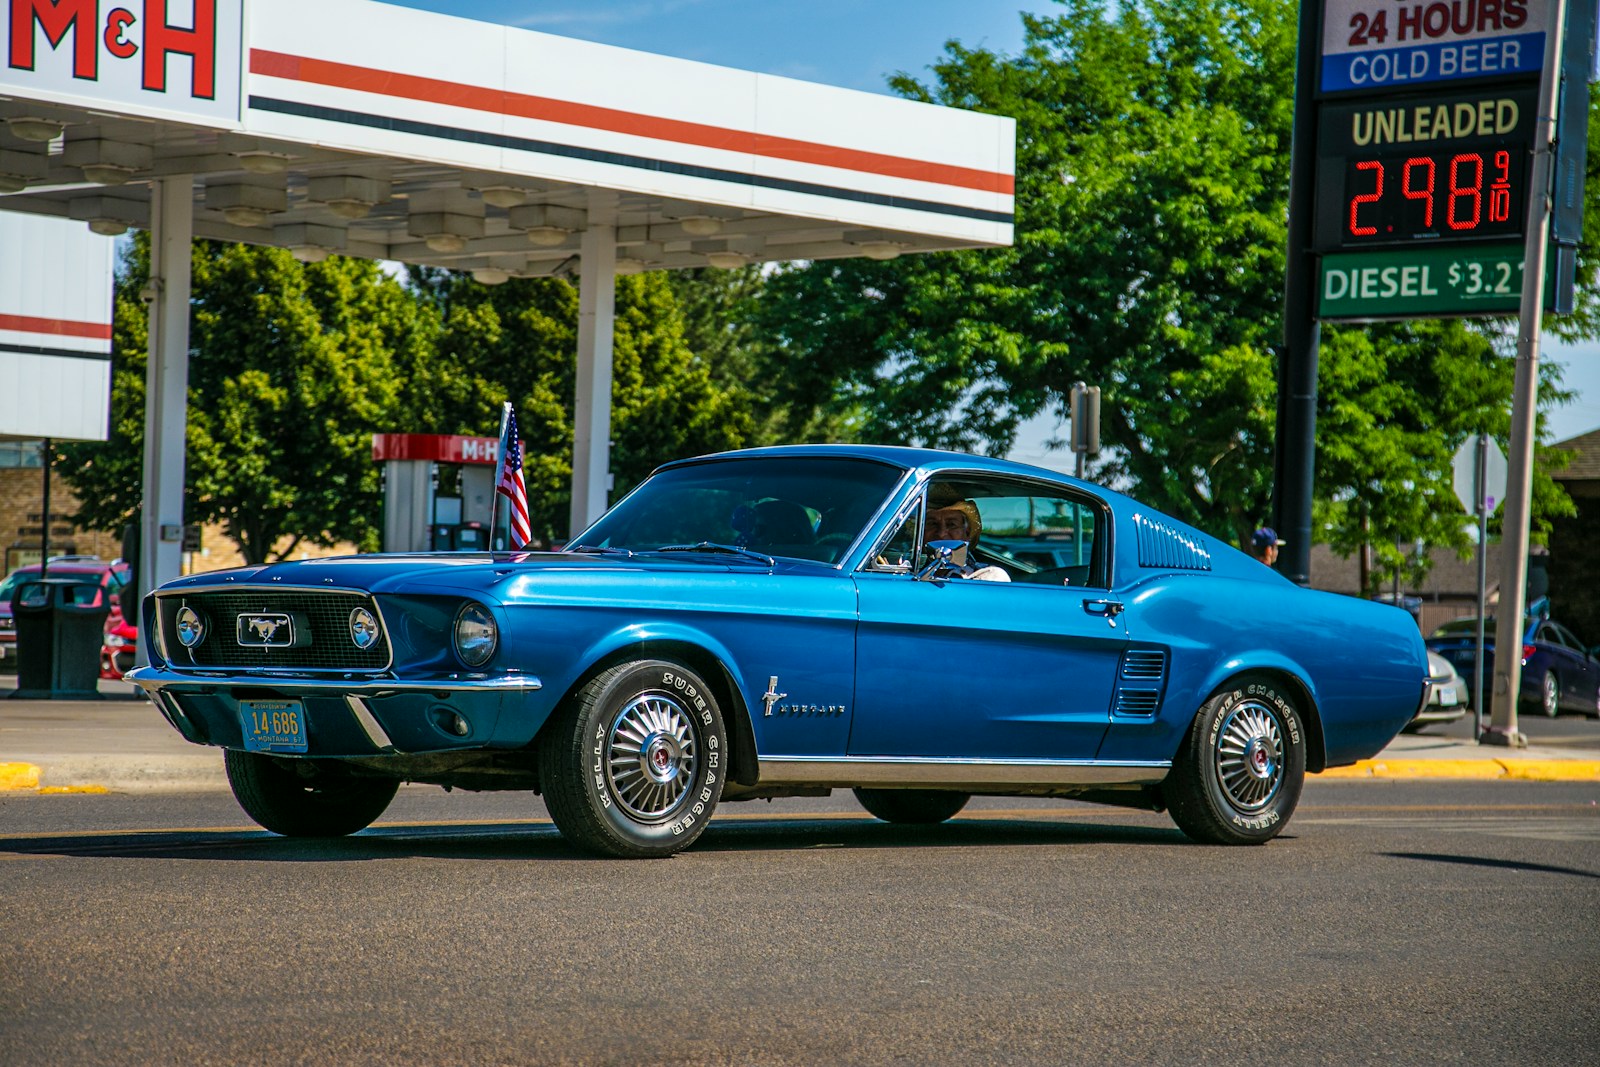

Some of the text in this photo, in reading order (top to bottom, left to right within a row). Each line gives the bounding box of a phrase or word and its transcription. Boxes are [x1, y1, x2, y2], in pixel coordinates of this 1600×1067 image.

[1348, 0, 1529, 46] 24 HOURS
[8, 0, 216, 101] M&H
[1350, 40, 1521, 85] COLD BEER
[1352, 99, 1519, 146] UNLEADED
[1349, 152, 1484, 237] 2.98
[1324, 261, 1526, 300] DIESEL $3.2
[594, 723, 612, 808] KELLY
[662, 672, 719, 836] SUPER CHARGER
[1233, 810, 1280, 830] KELLY
